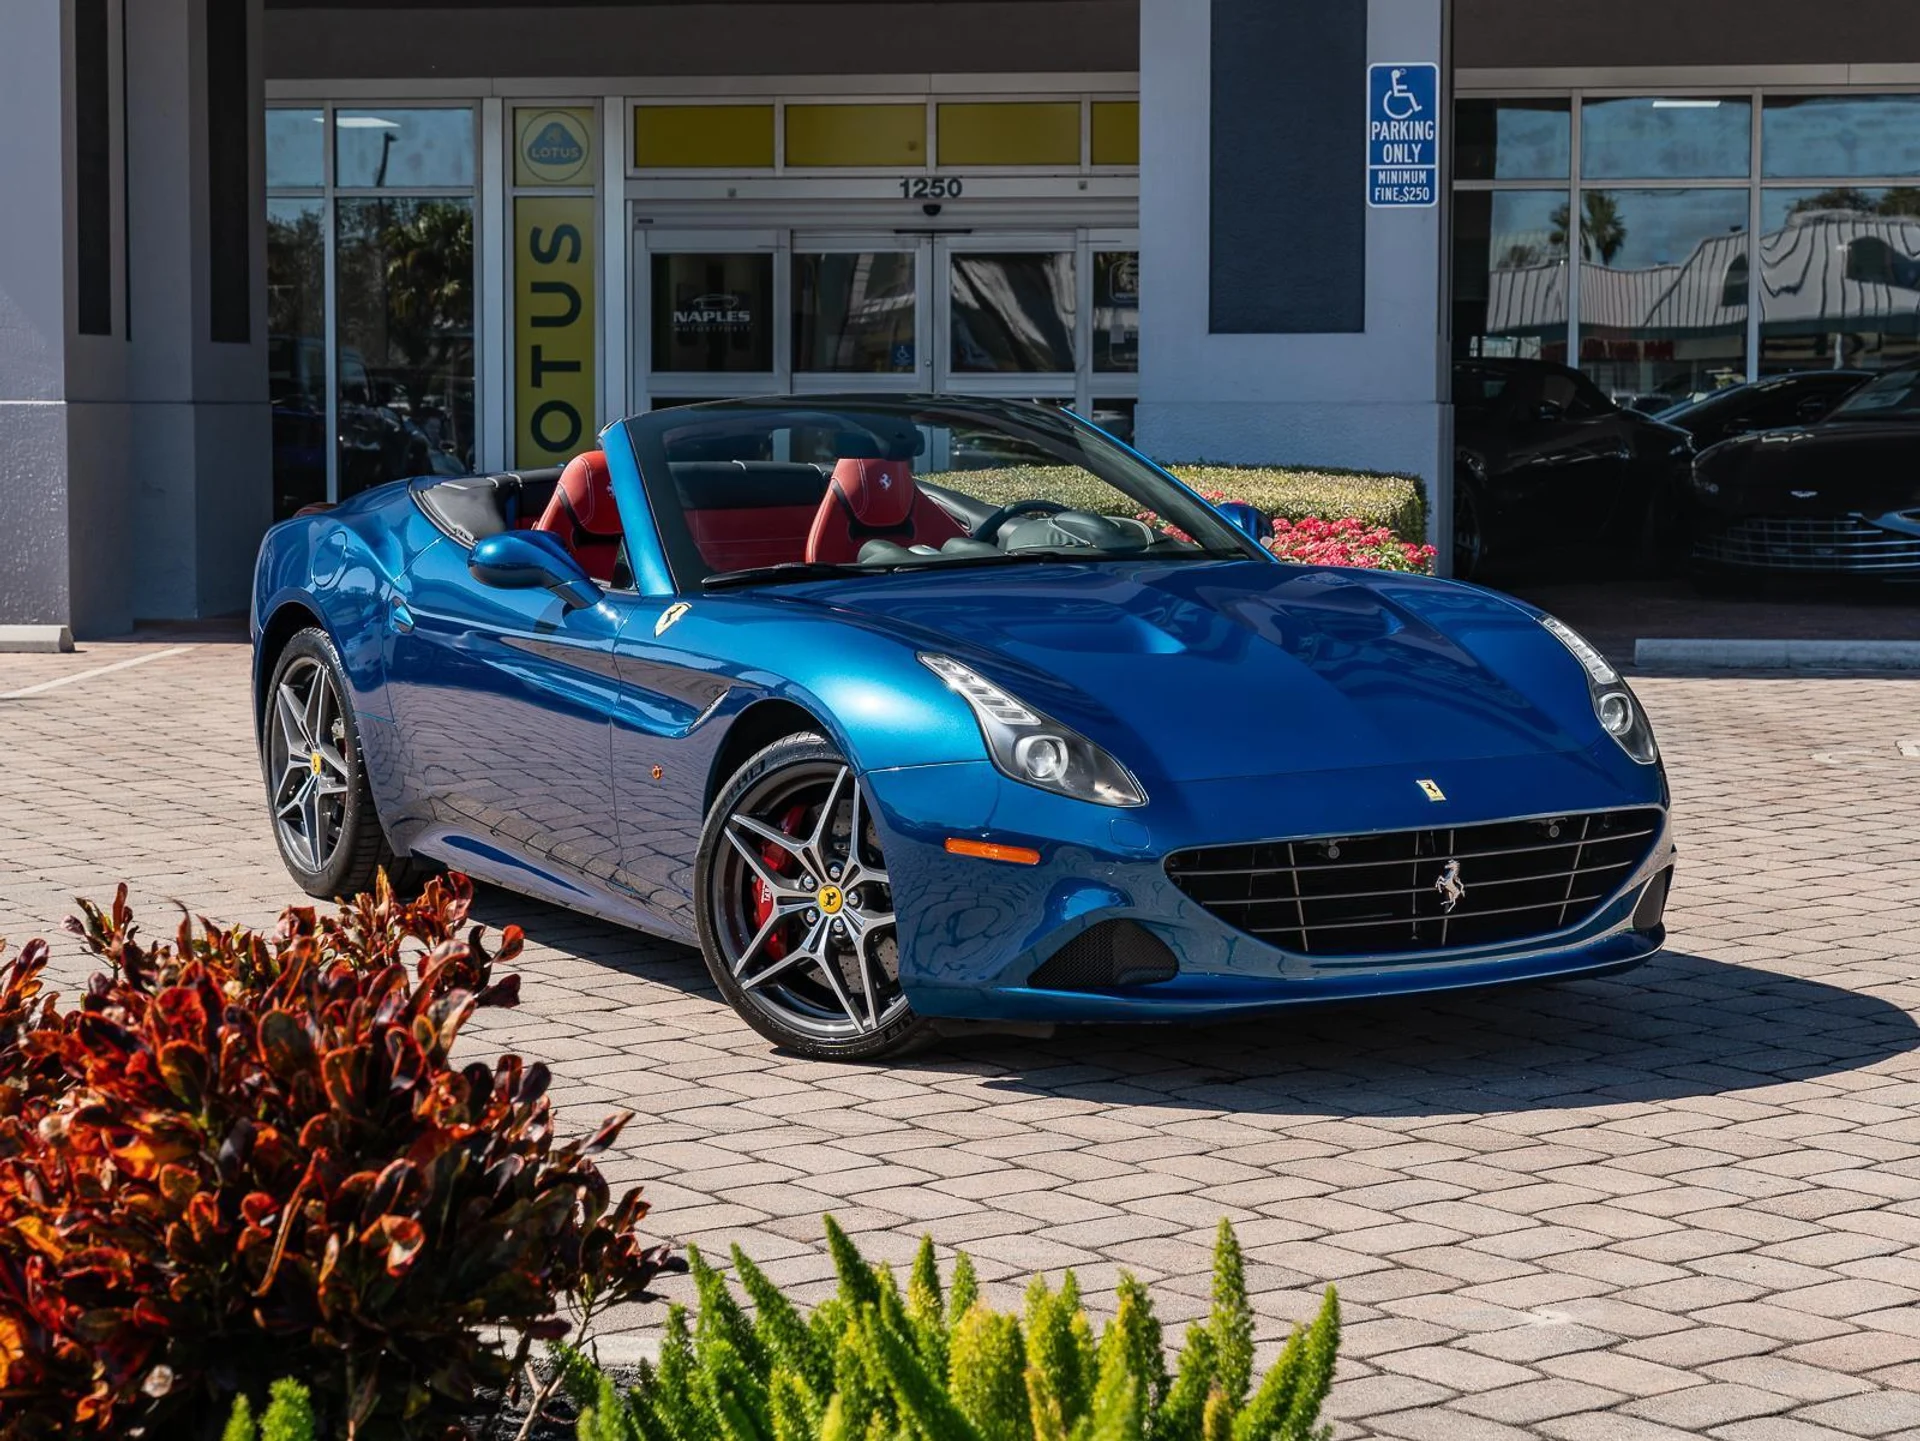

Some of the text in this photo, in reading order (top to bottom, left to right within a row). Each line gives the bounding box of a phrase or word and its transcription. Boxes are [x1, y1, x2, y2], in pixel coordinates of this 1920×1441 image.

[1371, 121, 1434, 141] PARKING
[531, 147, 580, 158] LOTUS
[1383, 143, 1422, 163] ONLY
[1378, 170, 1427, 184] MINIMUM
[899, 178, 962, 198] 1250
[1375, 186, 1430, 202] FINE $250
[673, 310, 750, 322] NAPLES
[530, 223, 582, 453] OTUS
